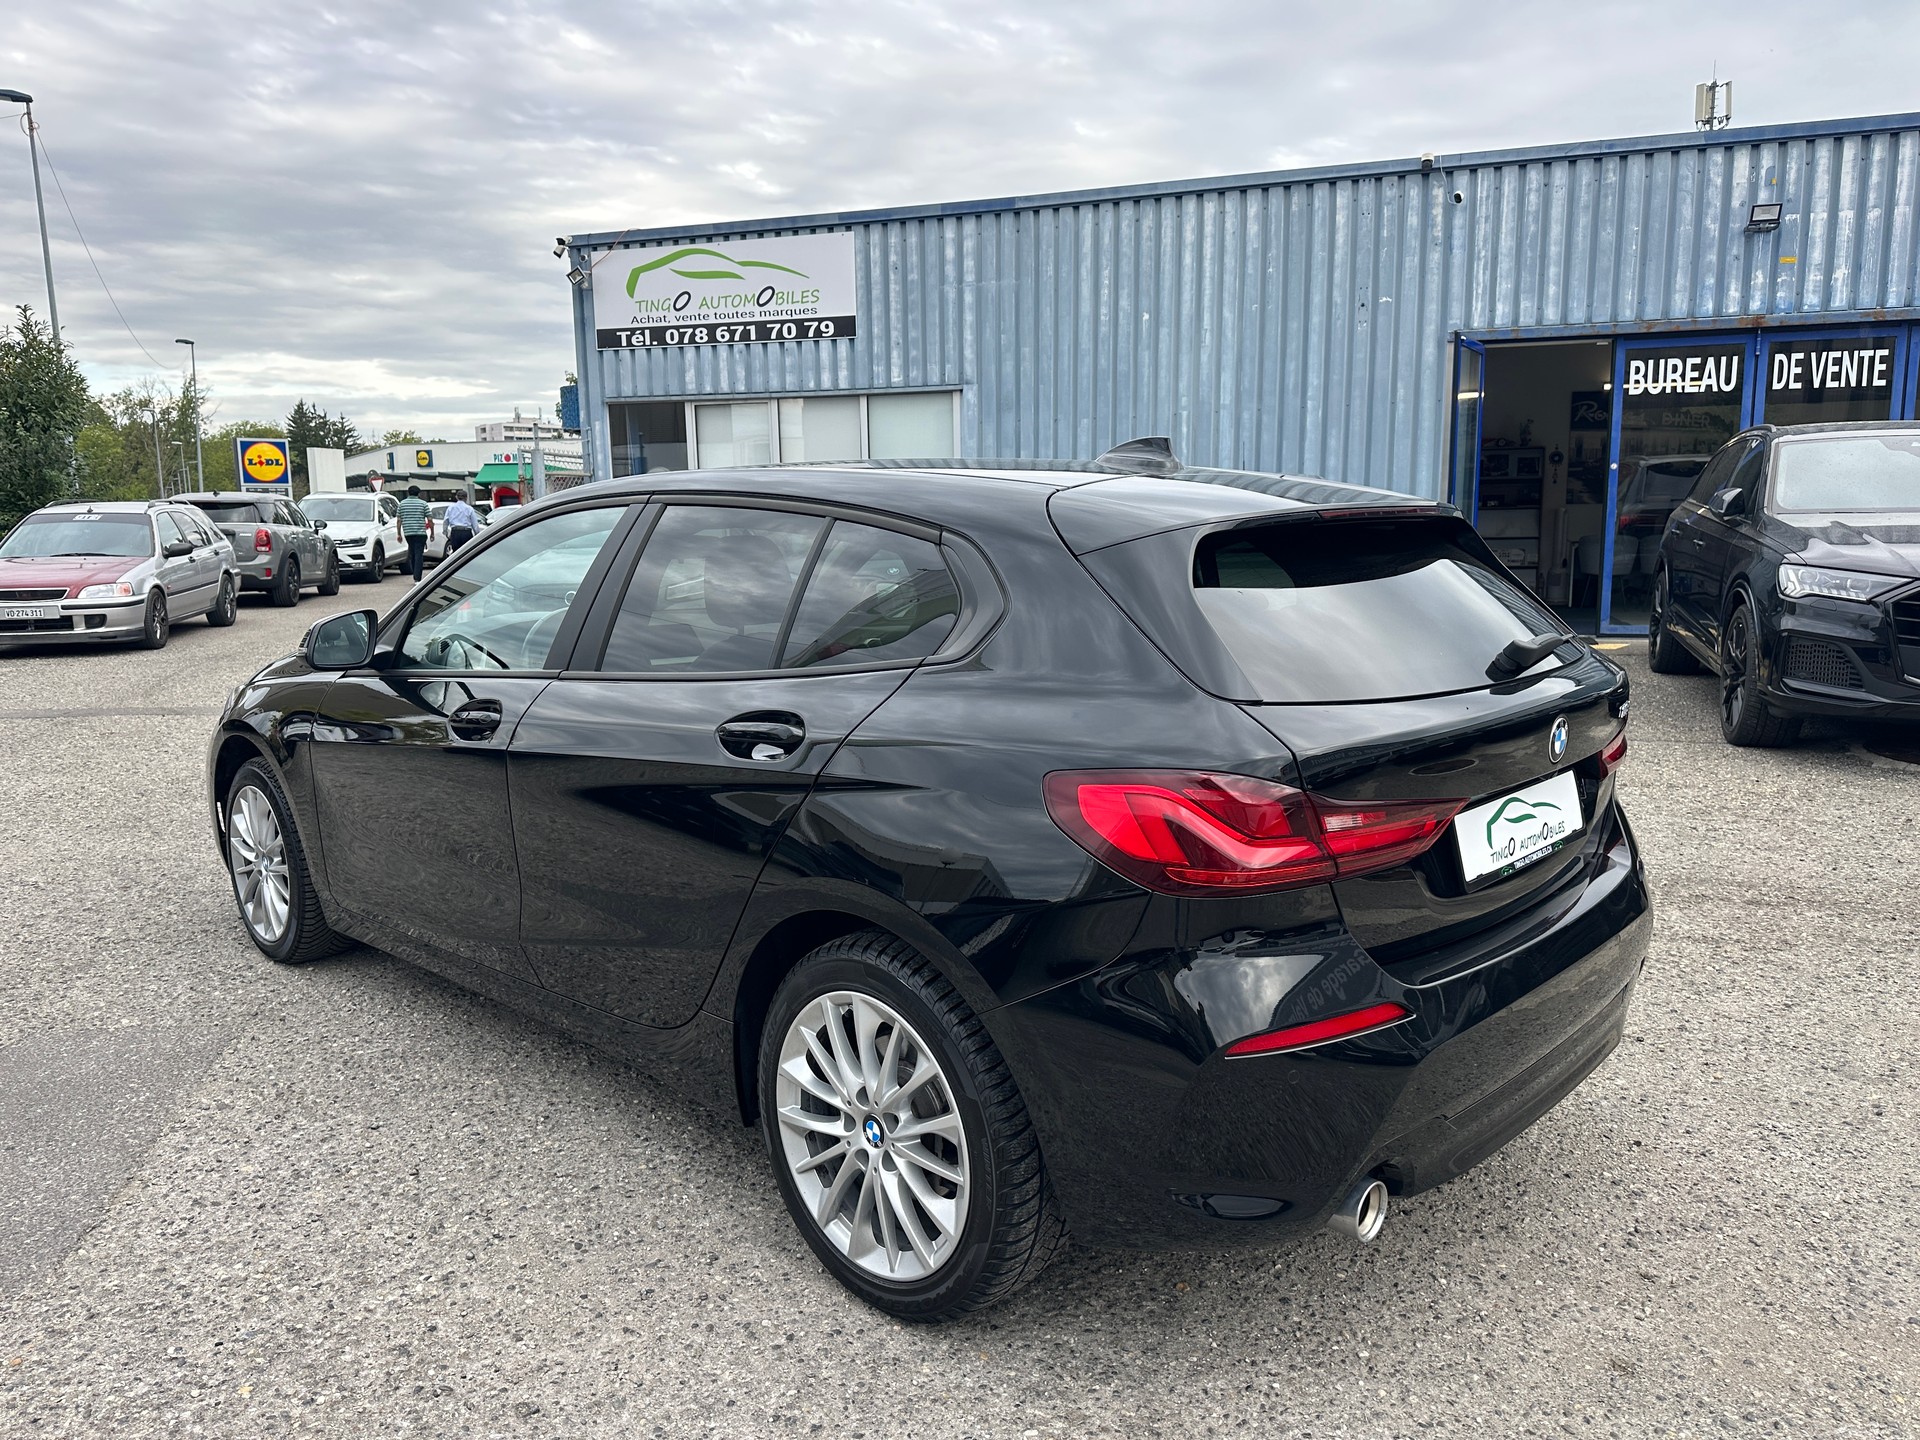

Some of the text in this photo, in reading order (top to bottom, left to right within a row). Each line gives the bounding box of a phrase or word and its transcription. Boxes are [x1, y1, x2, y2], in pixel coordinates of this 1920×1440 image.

[634, 285, 820, 313] TINGO AUTOMOBILES
[630, 307, 818, 325] Achat, vente toutes marques
[616, 320, 835, 347] Tél. 078 671 70 79
[1627, 348, 1890, 396] BUREAU DE VENTE
[1490, 837, 1516, 864] TINGO
[1519, 820, 1566, 852] AUTOMOBILES
